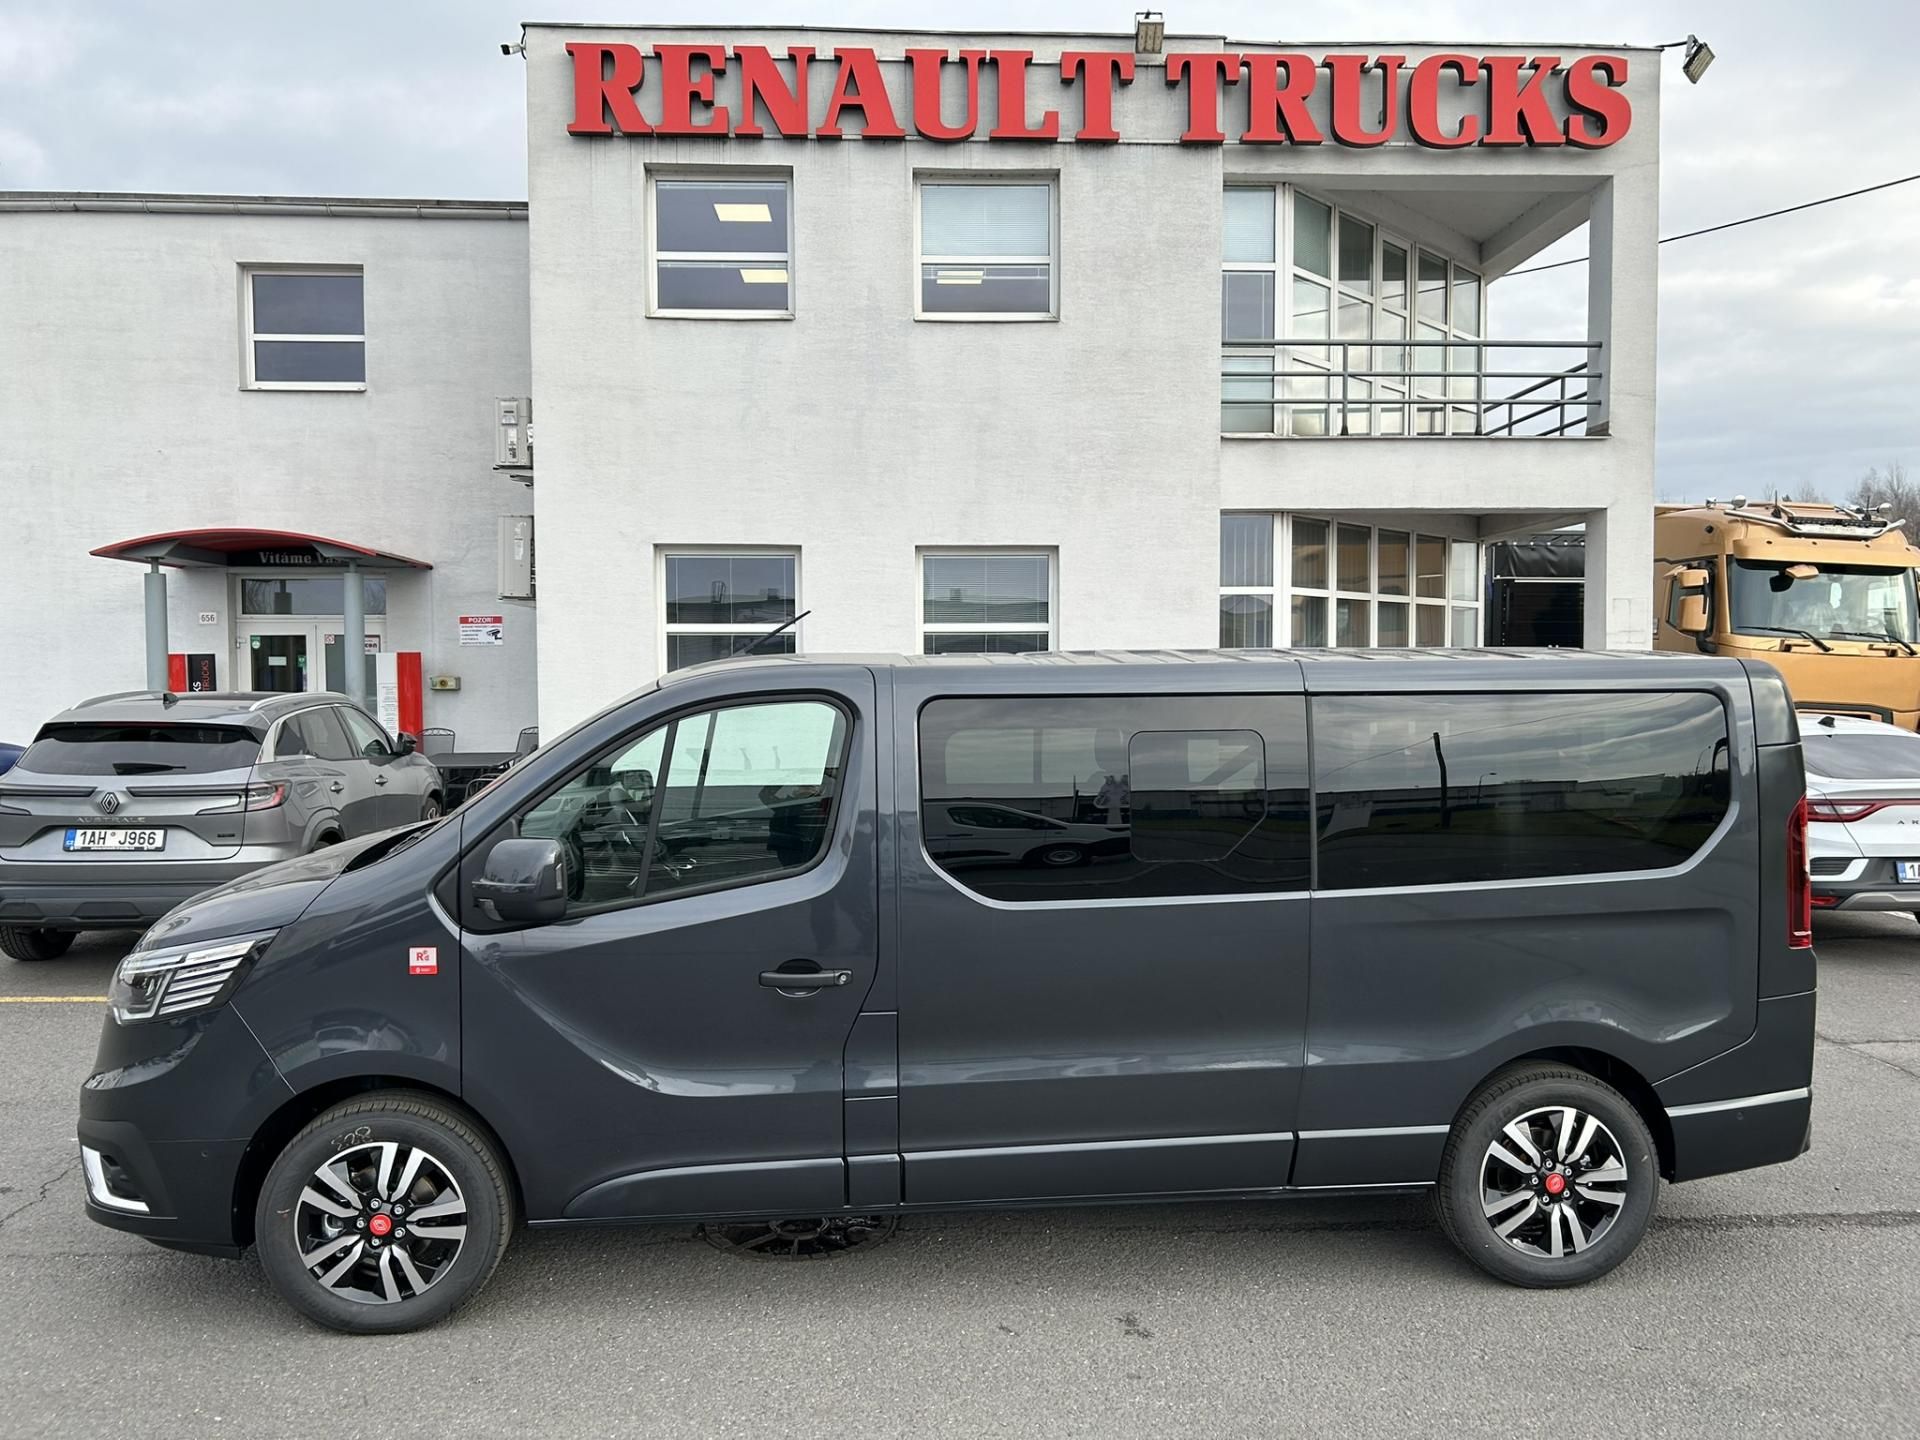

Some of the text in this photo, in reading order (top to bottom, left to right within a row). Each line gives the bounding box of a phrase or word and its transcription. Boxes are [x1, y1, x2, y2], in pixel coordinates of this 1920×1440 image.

[565, 42, 1632, 148] RENAULT TRUCKS
[201, 614, 215, 623] 656
[80, 830, 107, 845] 1AH
[118, 830, 157, 845] J966
